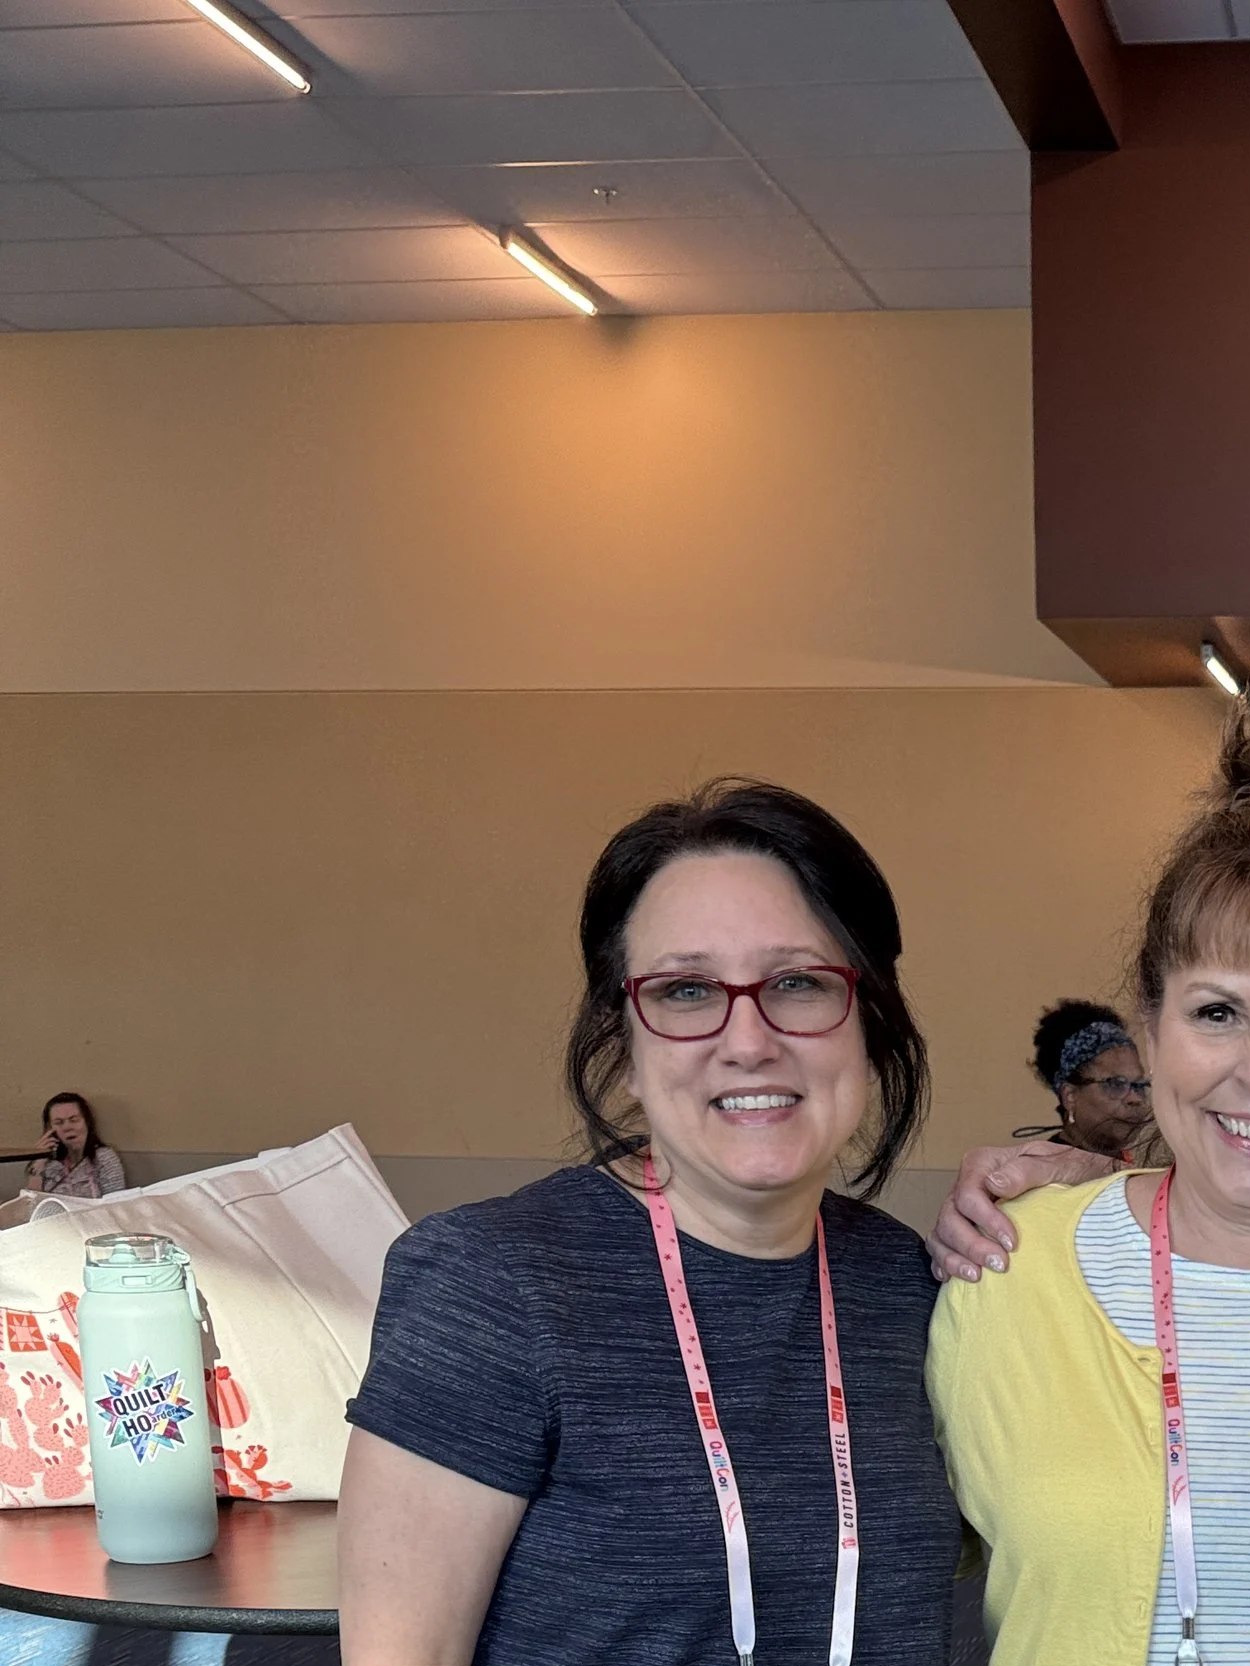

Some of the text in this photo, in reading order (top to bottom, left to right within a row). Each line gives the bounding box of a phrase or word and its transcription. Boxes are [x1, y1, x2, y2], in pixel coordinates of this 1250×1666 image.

[113, 1383, 166, 1416] QUILT
[709, 1440, 730, 1492] QuiltCon
[835, 1433, 849, 1469] STEEL
[1168, 1418, 1183, 1466] QuiltCon
[841, 1480, 854, 1528] COTTON
